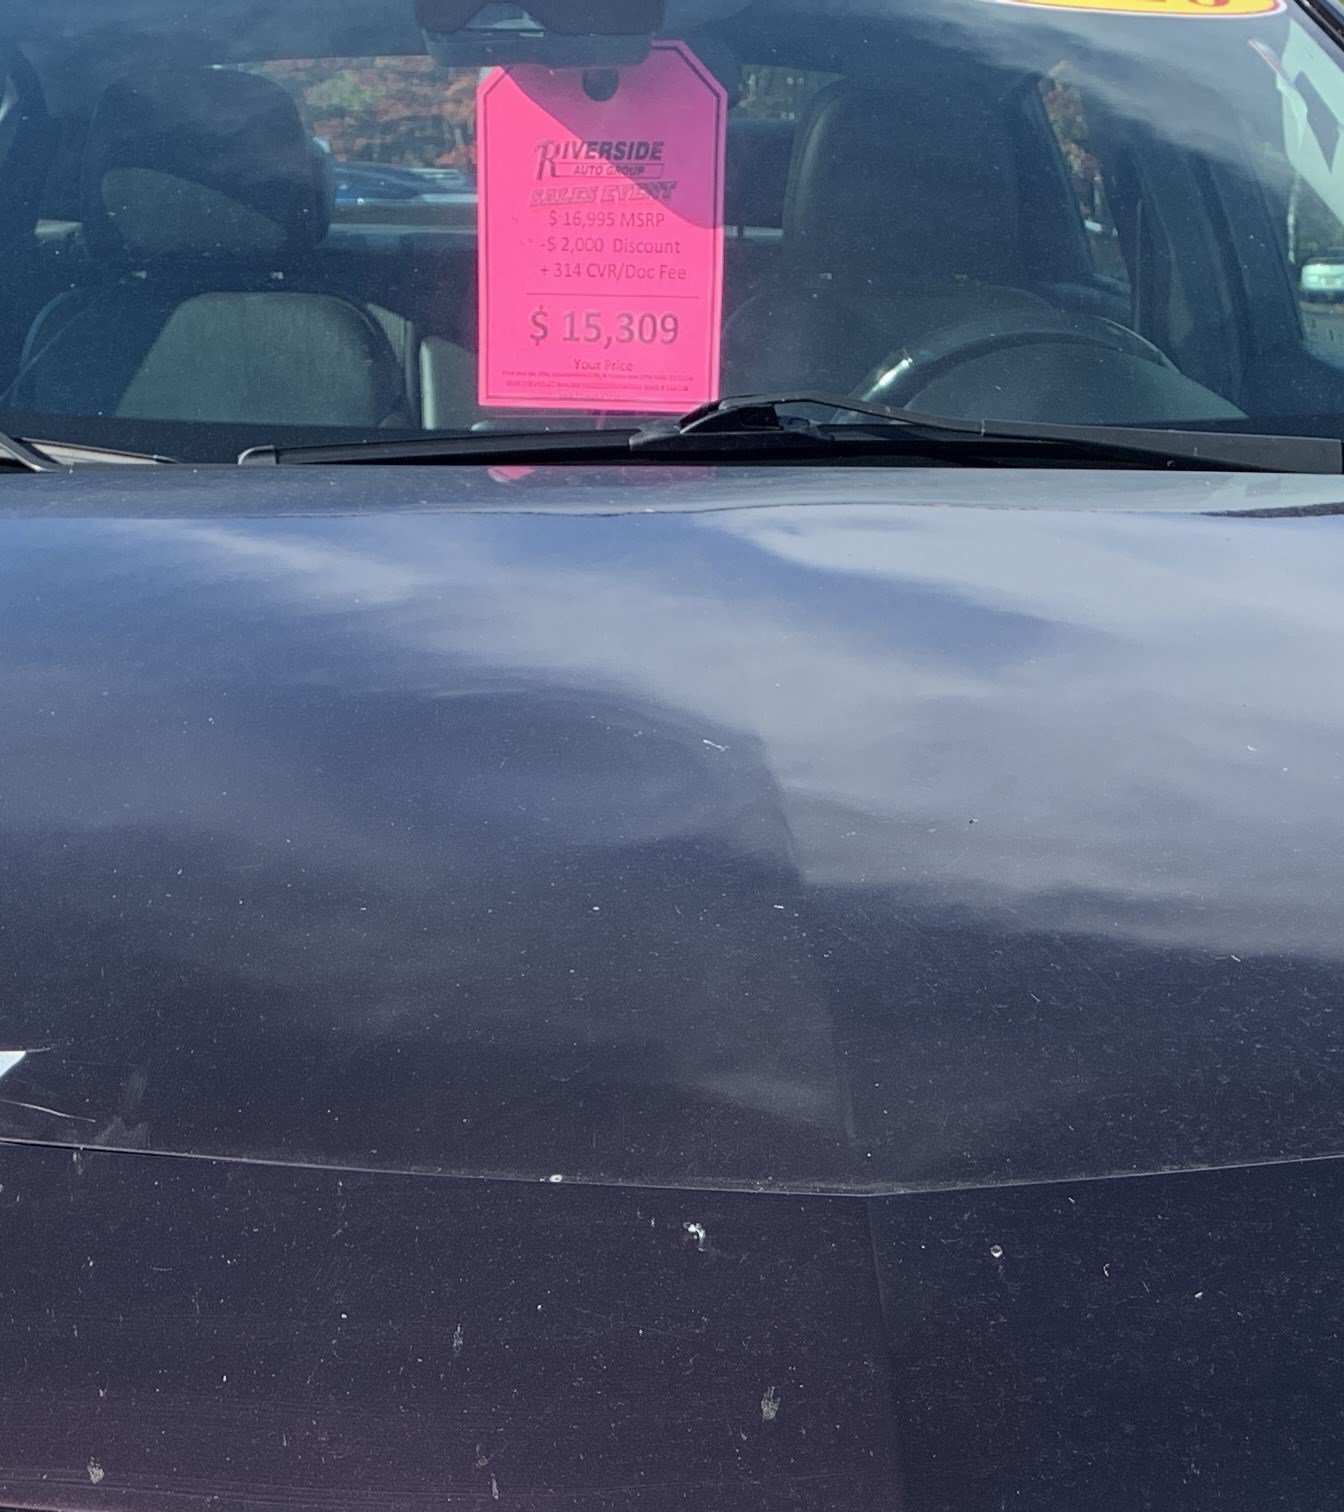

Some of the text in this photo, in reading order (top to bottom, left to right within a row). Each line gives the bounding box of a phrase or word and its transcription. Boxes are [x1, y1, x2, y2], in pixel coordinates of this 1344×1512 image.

[535, 140, 664, 180] RIVERSIDE
[573, 165, 644, 176] AUTO GROUP
[548, 210, 665, 228] $ 16,995 MSRP
[561, 237, 604, 254] 2,000
[613, 238, 681, 254] Discount
[554, 263, 582, 278] 314
[586, 263, 655, 280] CVR/Doc
[659, 265, 687, 280] Fee
[529, 305, 679, 350] $ 15,309
[574, 359, 634, 372] Your Price
